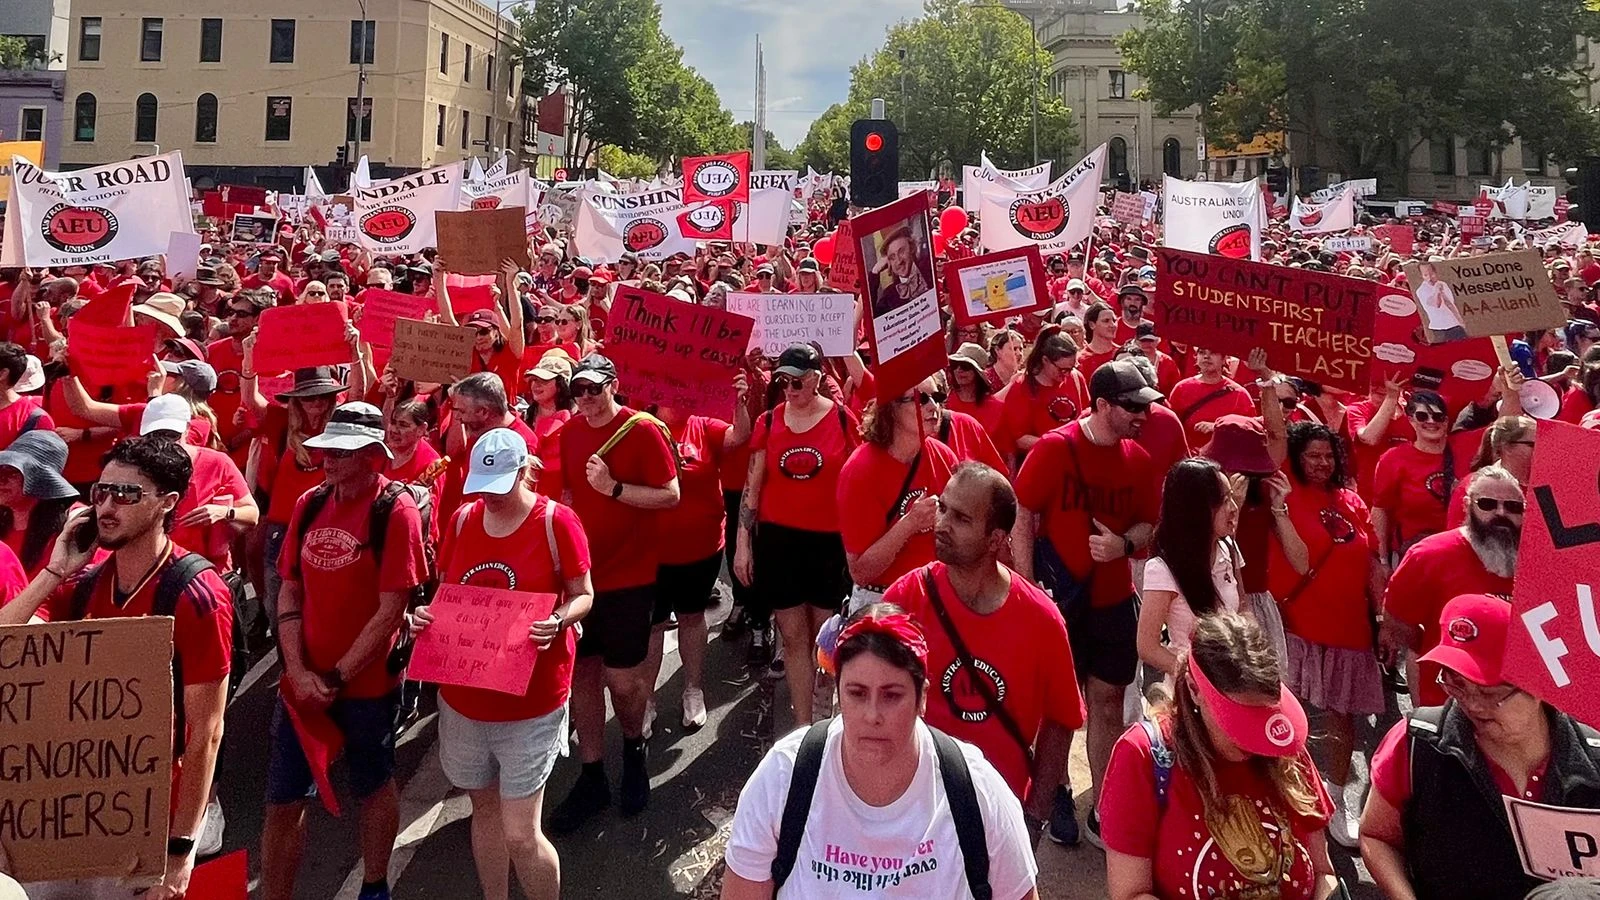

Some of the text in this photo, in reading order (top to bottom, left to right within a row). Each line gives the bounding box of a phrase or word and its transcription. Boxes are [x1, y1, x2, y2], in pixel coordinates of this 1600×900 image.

[94, 159, 171, 188] ROAD
[749, 174, 793, 191] REEK
[82, 189, 127, 203] SCHOOL
[383, 192, 418, 206] SCHOOL
[1171, 194, 1236, 208] AUSTRALIAN
[1020, 203, 1063, 223] AEU
[53, 219, 103, 234] AEU
[370, 218, 405, 231] AEU
[1031, 232, 1056, 240] UNION
[64, 244, 96, 252] UNION
[72, 254, 110, 263] BRANCH
[1450, 262, 1523, 279] You Done
[1161, 252, 1371, 316] YOU CAN'T PUT
[1452, 276, 1535, 297] Messed Up
[766, 296, 815, 312] LEARNING
[821, 296, 833, 311] TO
[623, 294, 680, 333] Think
[716, 319, 743, 341] be
[765, 312, 846, 325] OURSELVES TO ACCEPT
[765, 326, 842, 339] THE LOWEST IN THE
[1160, 300, 1207, 325] YOU
[1215, 312, 1260, 336] PUT
[1268, 321, 1372, 358] TEACHERS
[611, 325, 667, 354] giving
[674, 342, 694, 359] up
[1295, 352, 1365, 381] LAST
[482, 454, 495, 467] G
[520, 601, 535, 613] up
[0, 629, 103, 670] CAN'T
[974, 658, 1006, 702] EDUCATION
[68, 677, 143, 722] KIDS
[1271, 725, 1289, 737] AEU
[825, 843, 868, 867] Have
[870, 856, 903, 874] you
[811, 859, 839, 882] this
[842, 870, 873, 892] like
